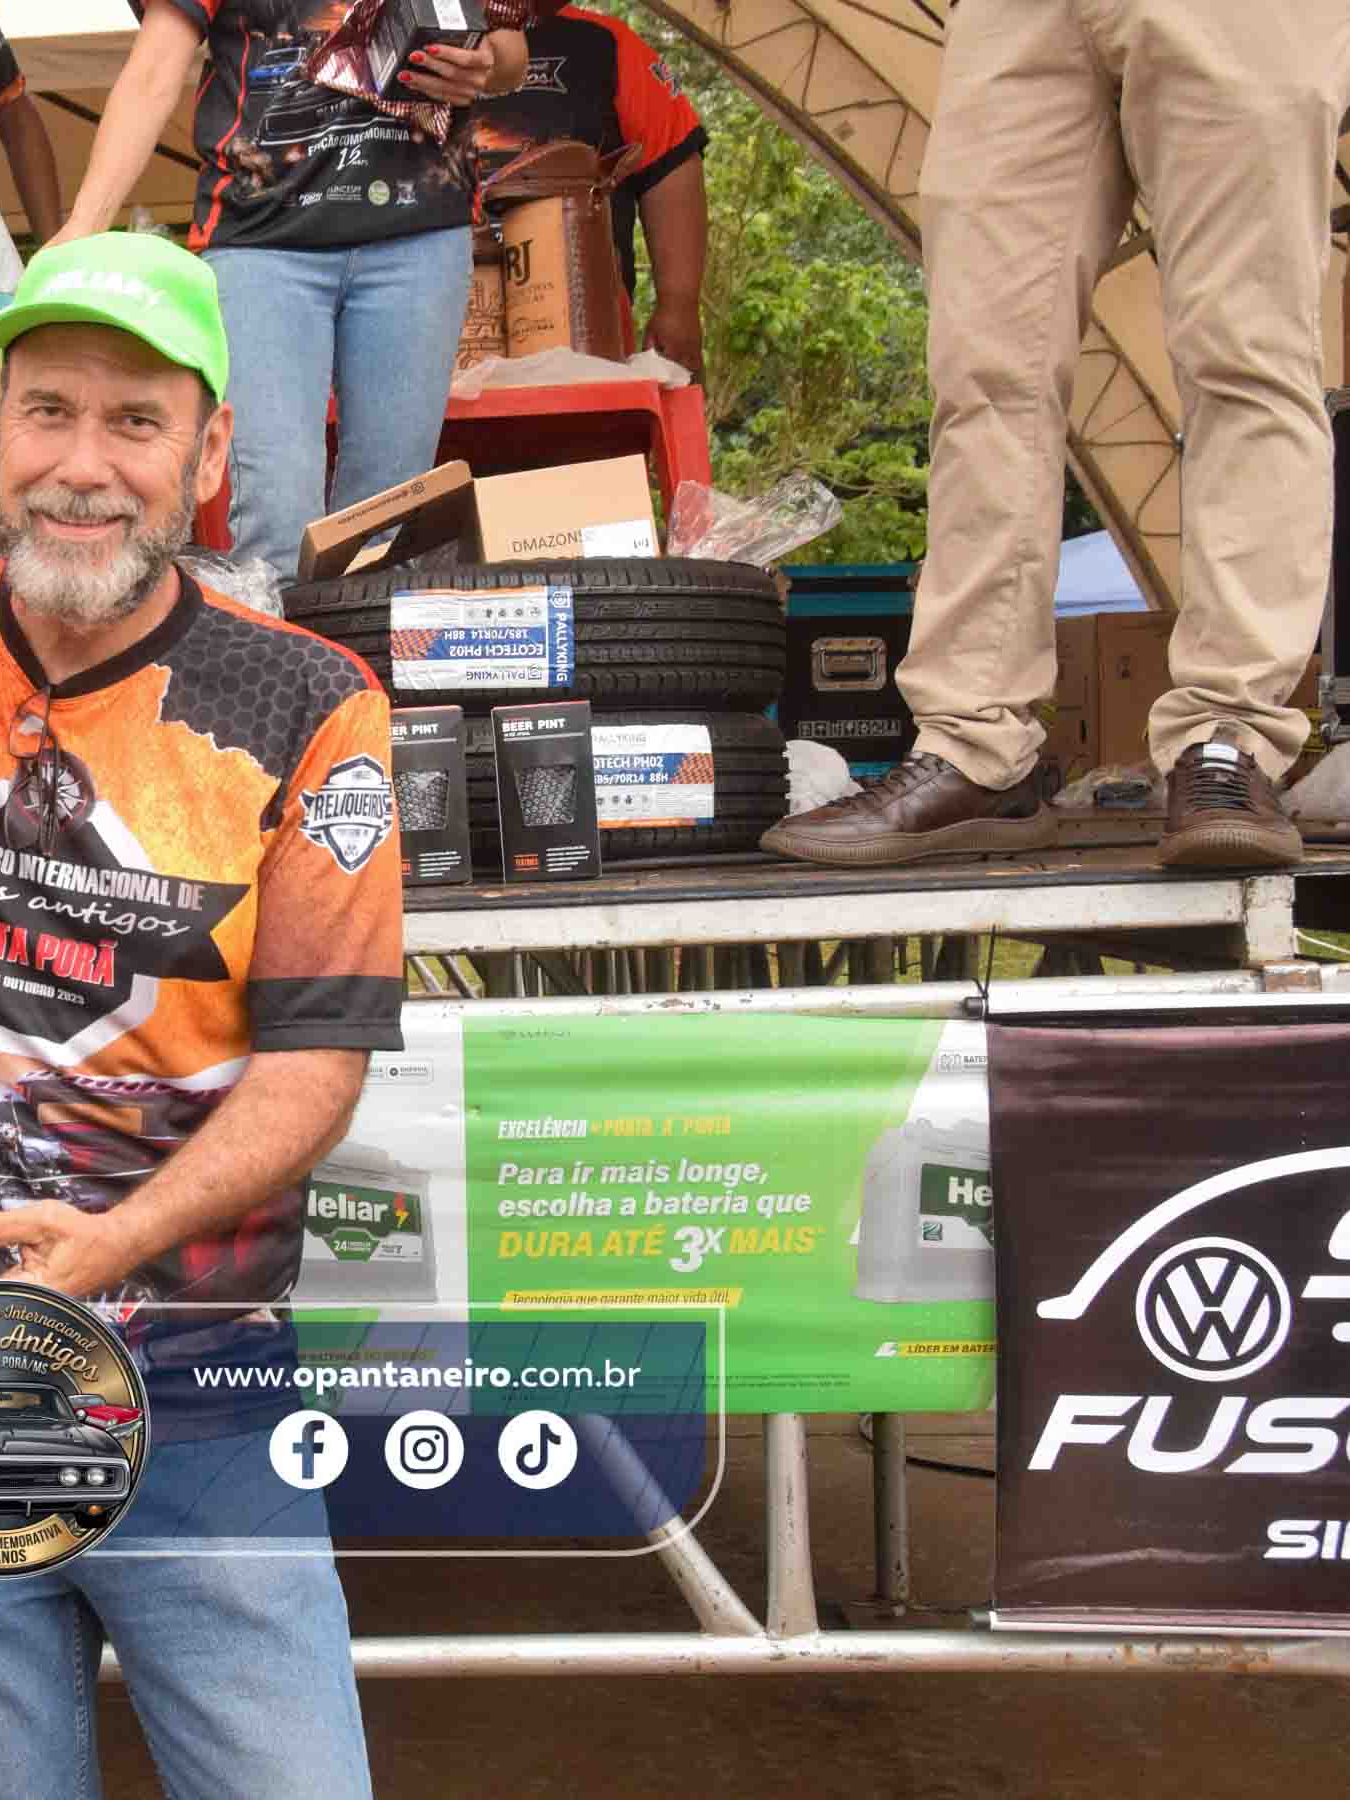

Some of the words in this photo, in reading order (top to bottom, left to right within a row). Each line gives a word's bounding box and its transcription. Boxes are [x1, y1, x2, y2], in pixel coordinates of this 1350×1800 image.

[444, 630, 465, 641] 88H
[471, 628, 528, 639] 185/70R14
[449, 644, 482, 657] PH02
[486, 643, 544, 656] ECOTECH
[556, 612, 570, 682] PALLYKING
[412, 723, 439, 736] PINT
[502, 720, 533, 733] BEER
[537, 717, 566, 730] PINT
[633, 755, 664, 769] PH02
[649, 772, 669, 783] 88H
[314, 792, 388, 821] RELIQUEIROS
[18, 852, 172, 907] INTERNACIONAL
[178, 883, 205, 912] DE
[28, 893, 191, 937] antigos
[498, 1116, 588, 1139] EXCELÊNCIA
[498, 1163, 564, 1186] Para
[571, 1161, 594, 1184] ir
[601, 1159, 670, 1184] mais
[677, 1158, 770, 1188] longe,
[498, 1192, 612, 1218] escolha
[620, 1199, 637, 1217] a
[644, 1190, 749, 1217] bateria
[756, 1193, 812, 1219] que
[498, 1230, 592, 1260] DURA
[601, 1223, 667, 1256] ATÉ
[647, 1291, 678, 1305] maior
[680, 1290, 708, 1304] vida
[907, 1341, 942, 1354] LÍDER
[943, 1342, 960, 1354] EM
[1027, 1394, 1350, 1474] FUS
